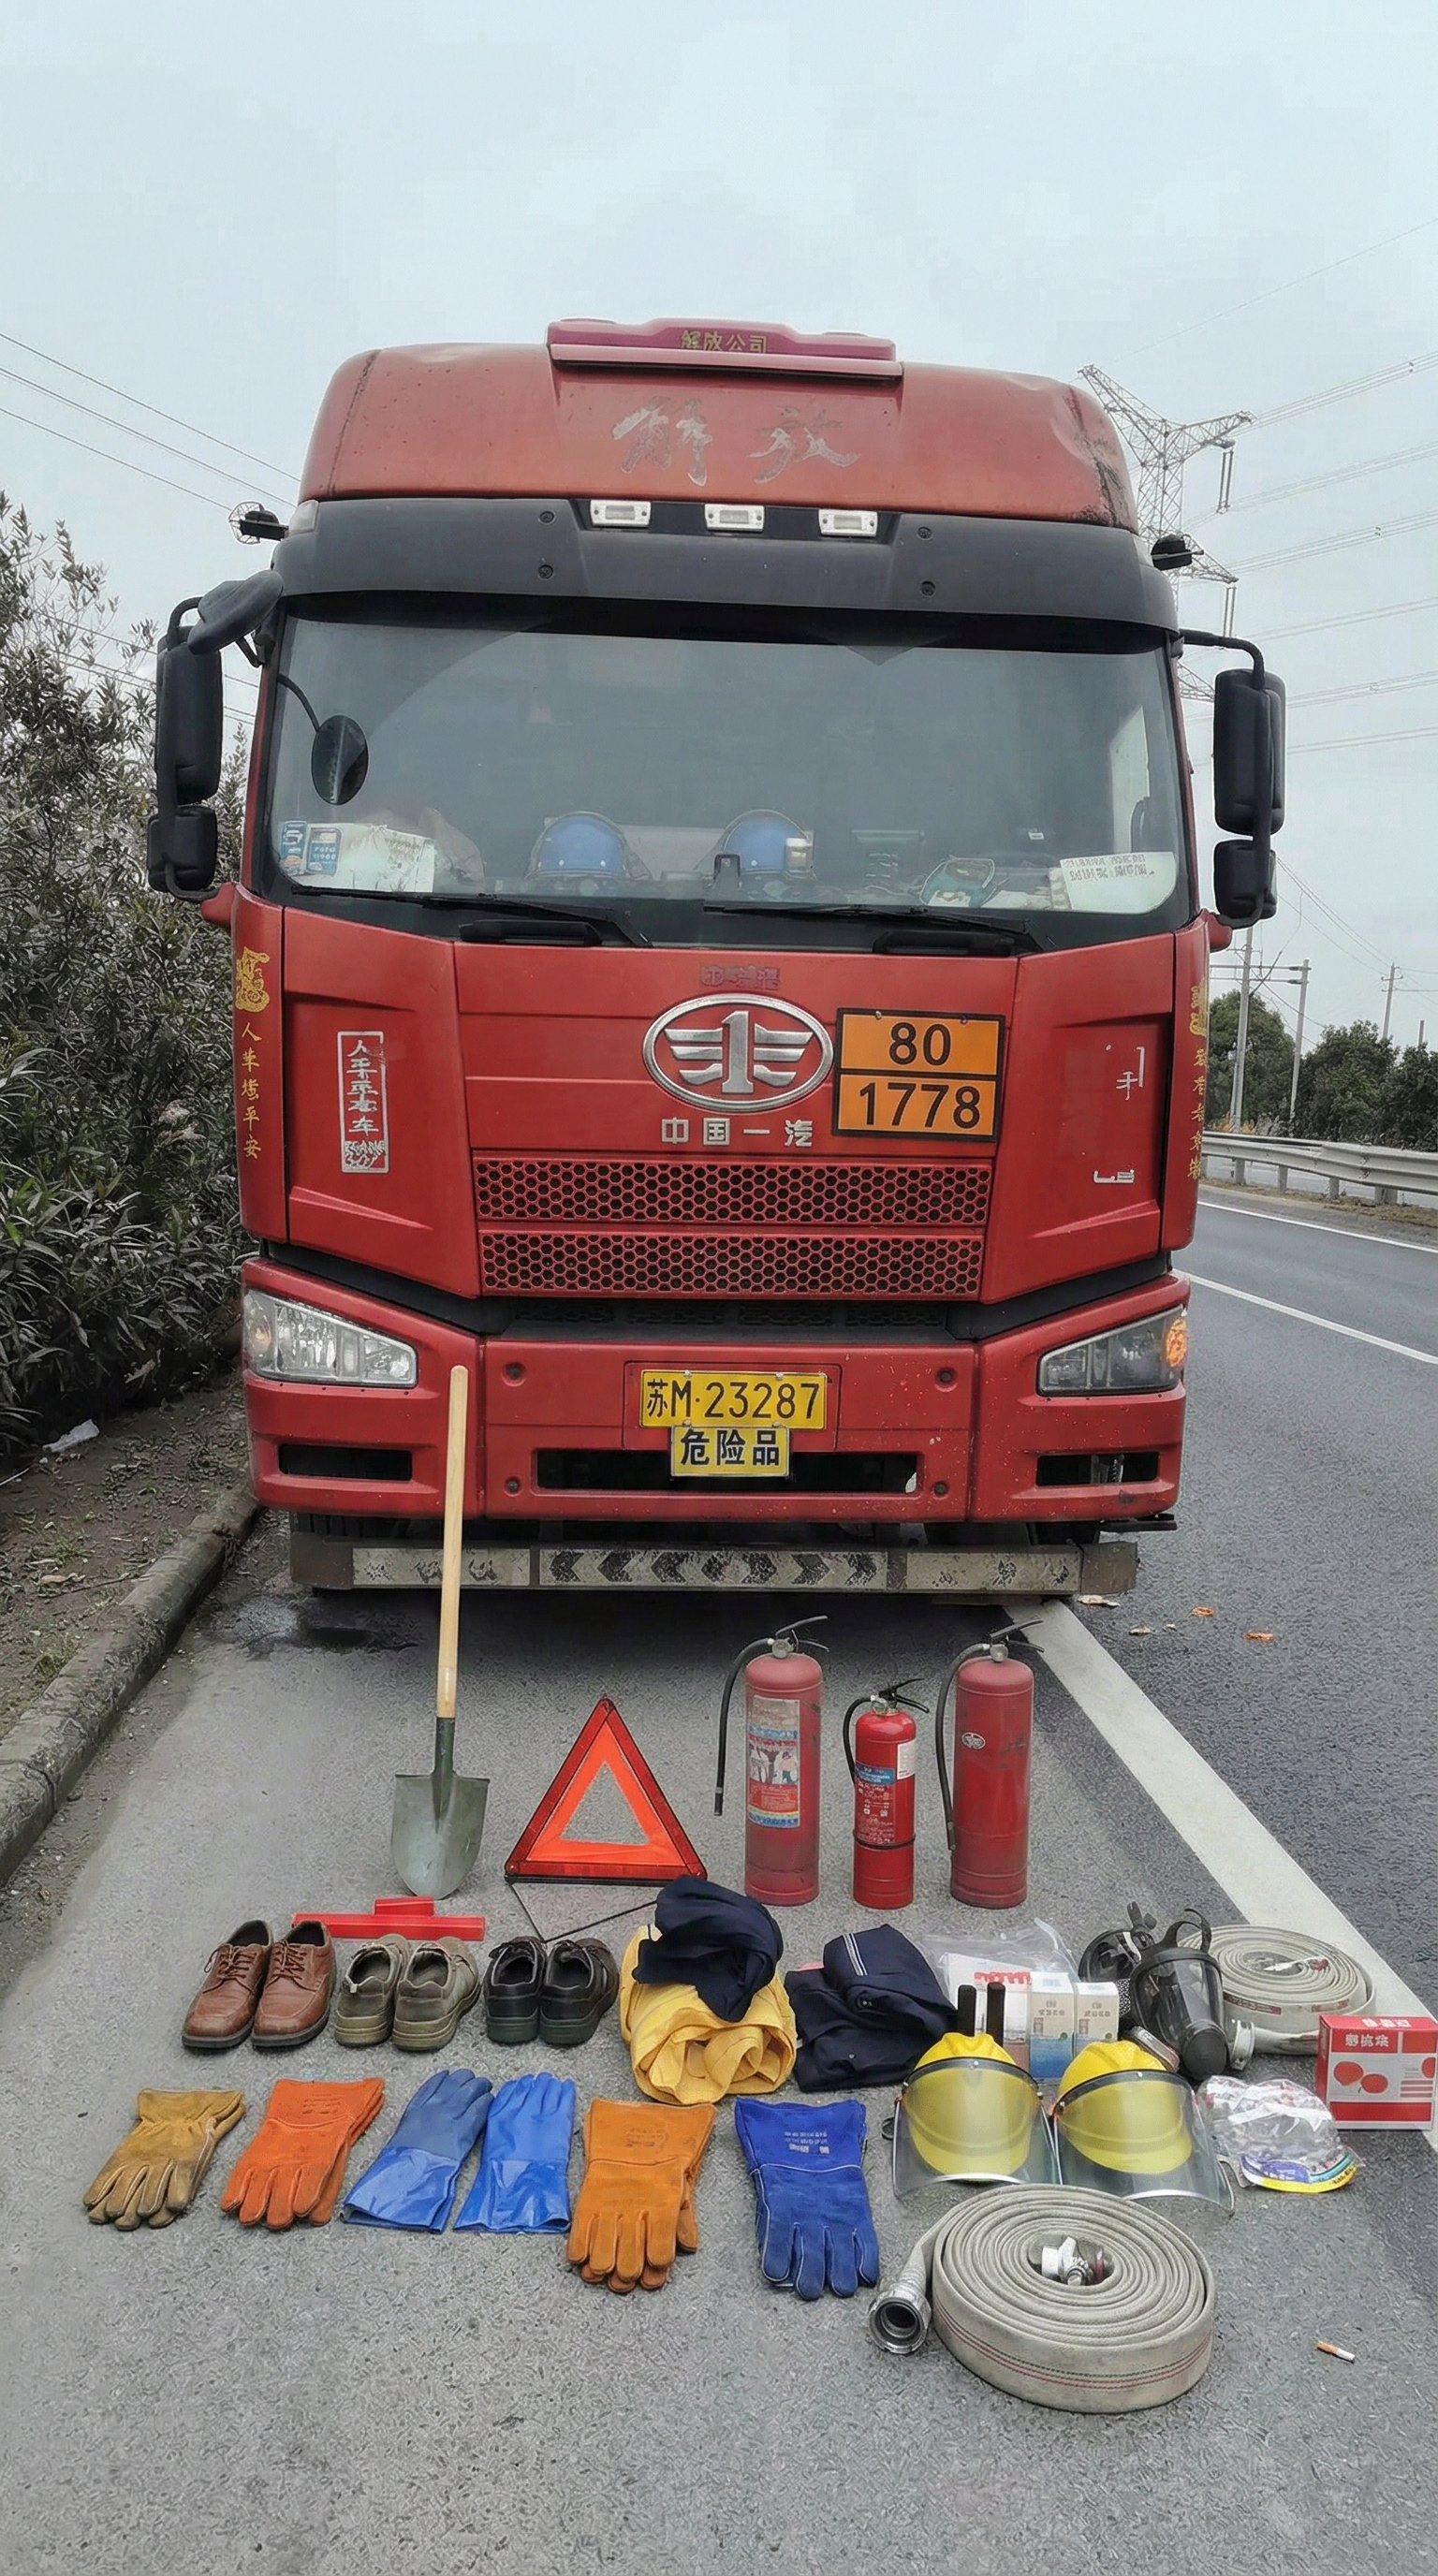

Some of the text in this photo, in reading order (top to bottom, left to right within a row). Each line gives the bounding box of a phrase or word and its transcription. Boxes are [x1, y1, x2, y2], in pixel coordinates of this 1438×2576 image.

[888, 1022, 951, 1066] 80
[858, 1082, 981, 1130] 1778
[661, 1117, 814, 1148] 中国一汽
[680, 1428, 780, 1466] 危险品
